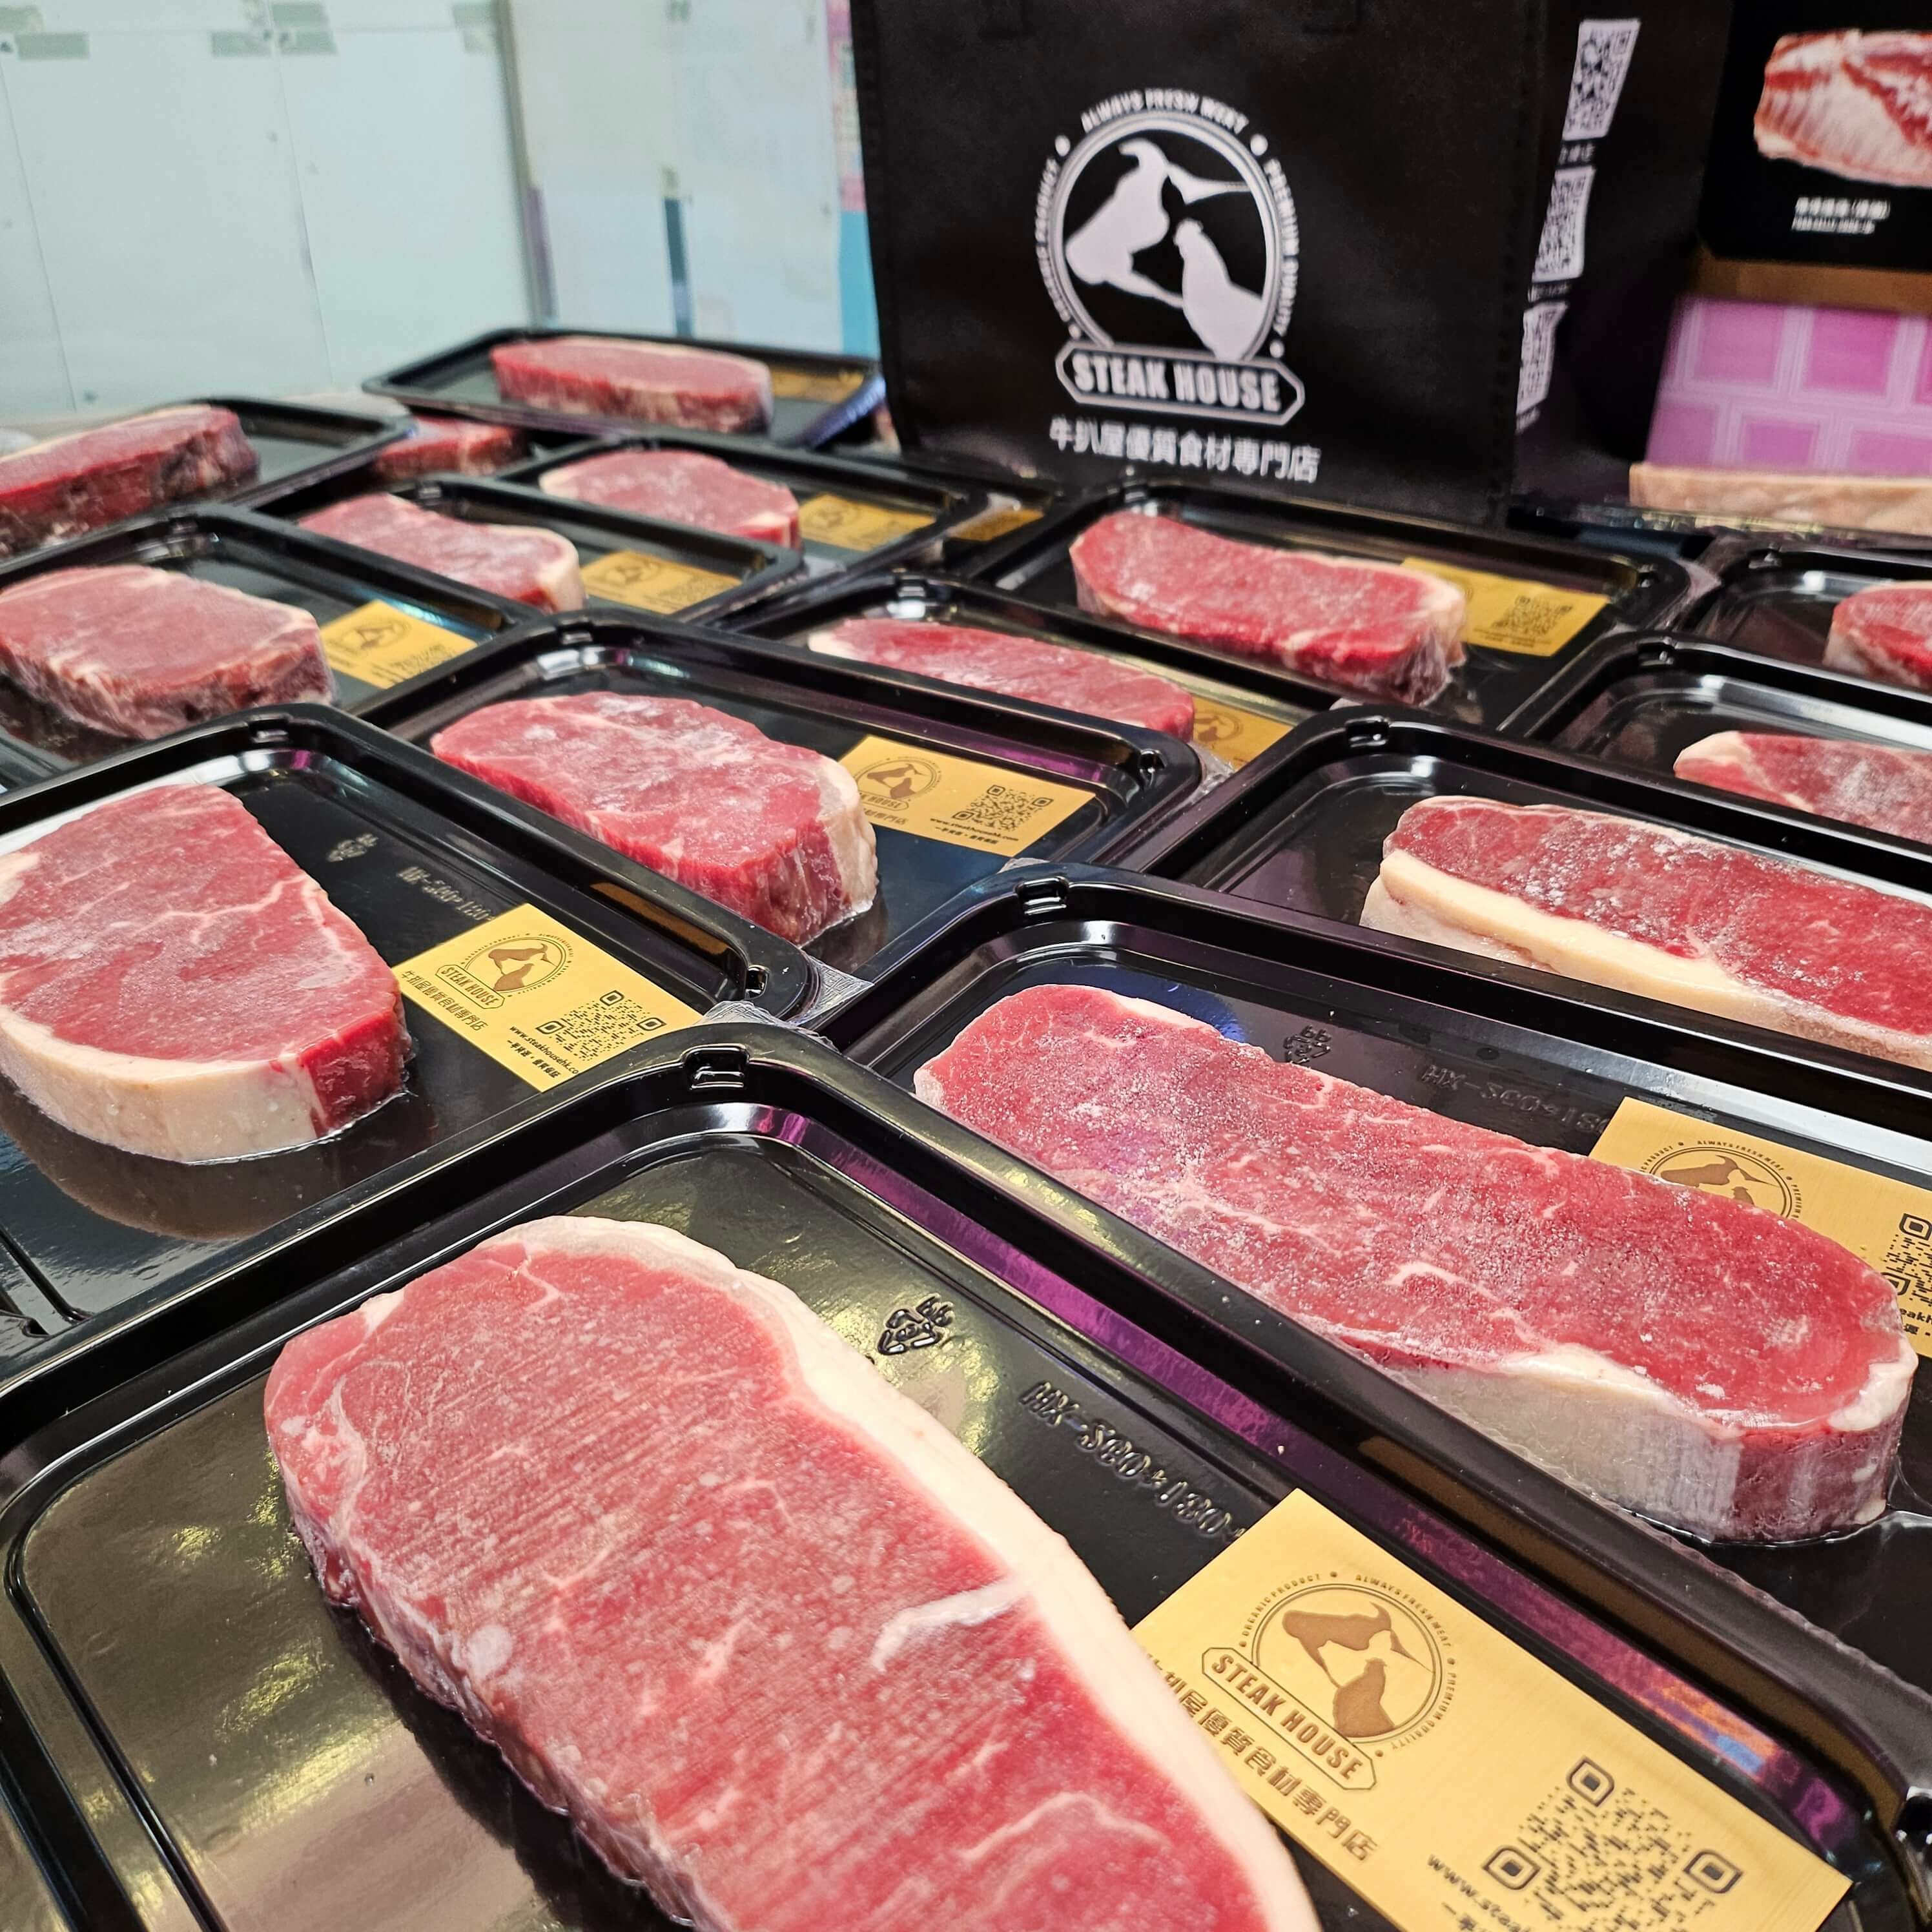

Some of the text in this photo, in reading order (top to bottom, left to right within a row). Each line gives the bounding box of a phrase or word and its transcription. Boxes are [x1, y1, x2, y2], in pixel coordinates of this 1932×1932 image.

[1072, 352, 1282, 413] STEAK HOUSE
[442, 966, 500, 1006] STEAK HOUSE
[1735, 1145, 1764, 1158] FRESH
[1242, 1573, 1320, 1636] ORGANIC PRODUCT
[1355, 1574, 1452, 1647] ALWAYS FRESH MEAT
[1211, 1654, 1364, 1780] STEAK HOUSE
[1391, 1672, 1457, 1751] PREMIUM QUALITY
